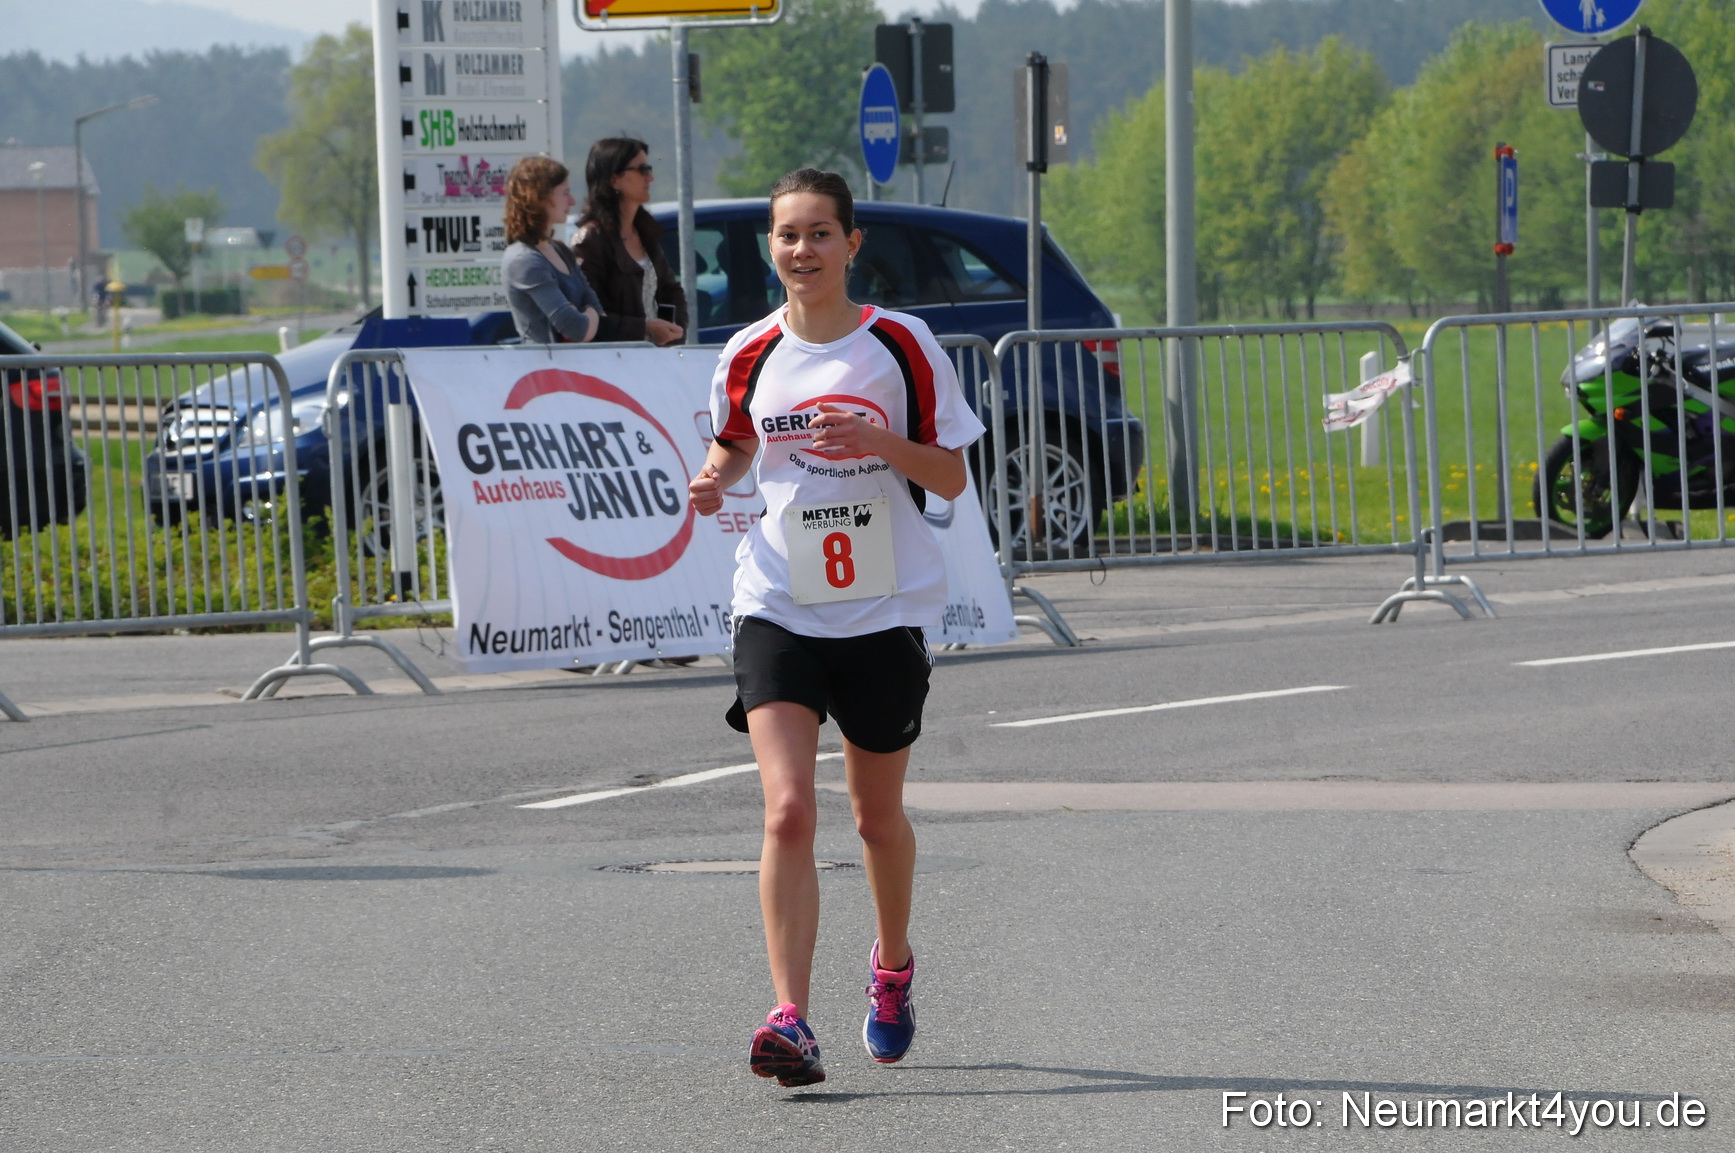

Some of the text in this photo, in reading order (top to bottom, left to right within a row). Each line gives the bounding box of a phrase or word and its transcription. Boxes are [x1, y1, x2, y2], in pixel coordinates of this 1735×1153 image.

[1556, 69, 1583, 83] scha
[1556, 86, 1578, 100] Ver
[419, 108, 456, 149] SHB
[422, 215, 481, 254] THULE
[458, 421, 654, 475] GERHART &
[766, 432, 813, 444] Autohaus
[789, 452, 806, 469] Das
[806, 462, 856, 478] sportliche
[472, 467, 681, 521] Autohaus JÄNIG
[802, 506, 850, 522] MEYER
[802, 517, 852, 530] WERBUNG
[822, 531, 856, 589] 8
[469, 614, 592, 656] Neumarkt
[608, 604, 704, 649] Sengenthal
[710, 603, 733, 636] Te
